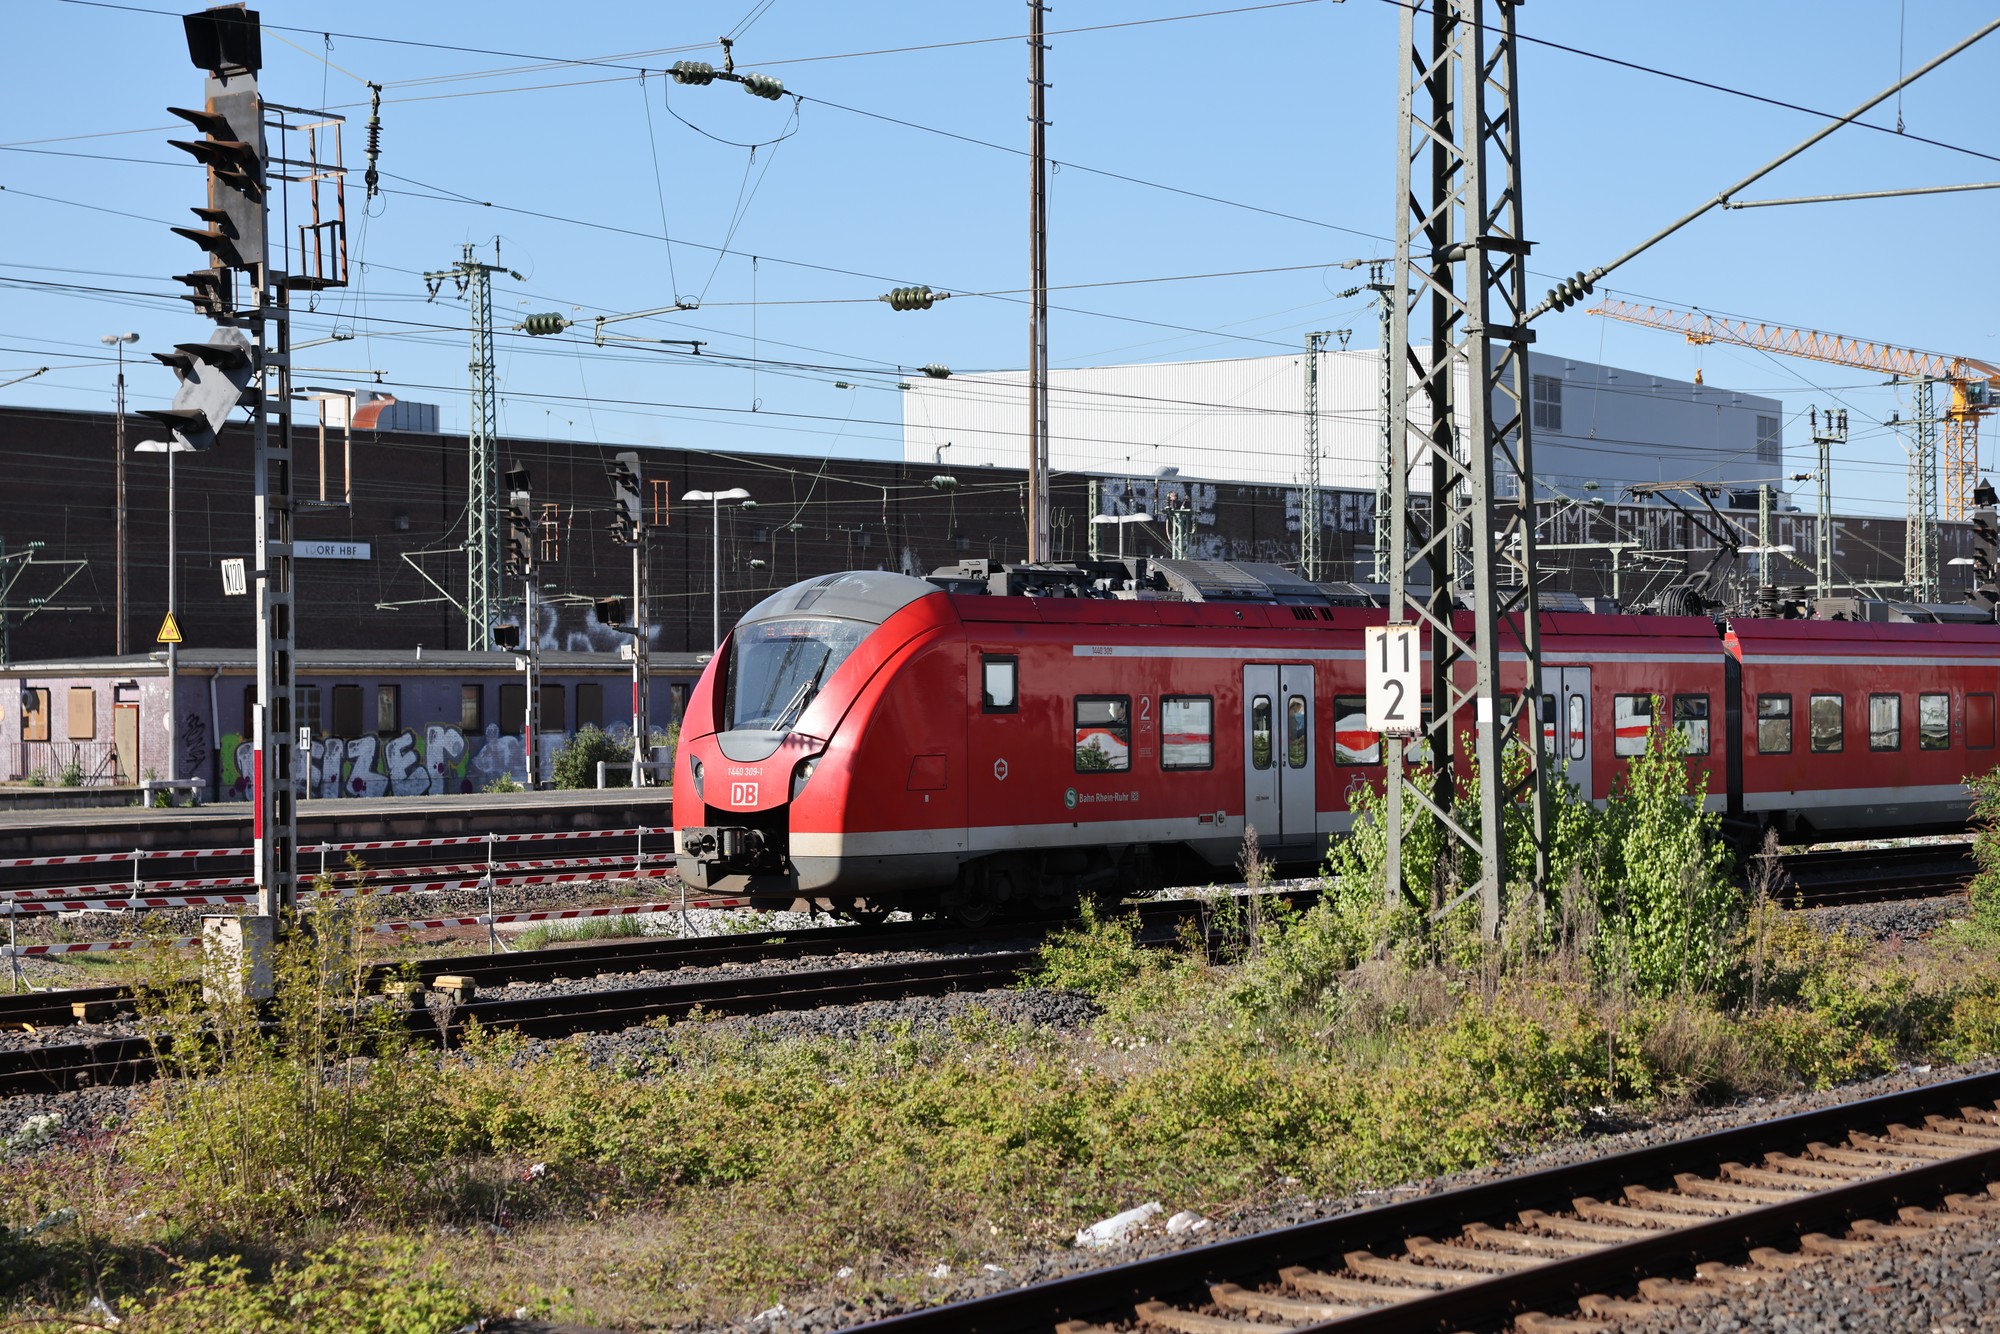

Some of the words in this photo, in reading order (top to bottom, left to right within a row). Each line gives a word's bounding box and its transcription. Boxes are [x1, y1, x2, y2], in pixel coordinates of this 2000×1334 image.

[339, 545, 357, 556] HBF
[223, 562, 244, 591] N120
[1376, 631, 1410, 673] 11
[1140, 696, 1151, 721] 2
[1383, 678, 1405, 720] 2
[301, 729, 309, 747] H
[728, 767, 744, 776] 1440
[745, 767, 763, 776] 309-1
[732, 784, 757, 804] DB
[1065, 788, 1076, 808] S
[1079, 793, 1095, 803] Bahn
[1096, 792, 1129, 802] Rhein-Ruhr
